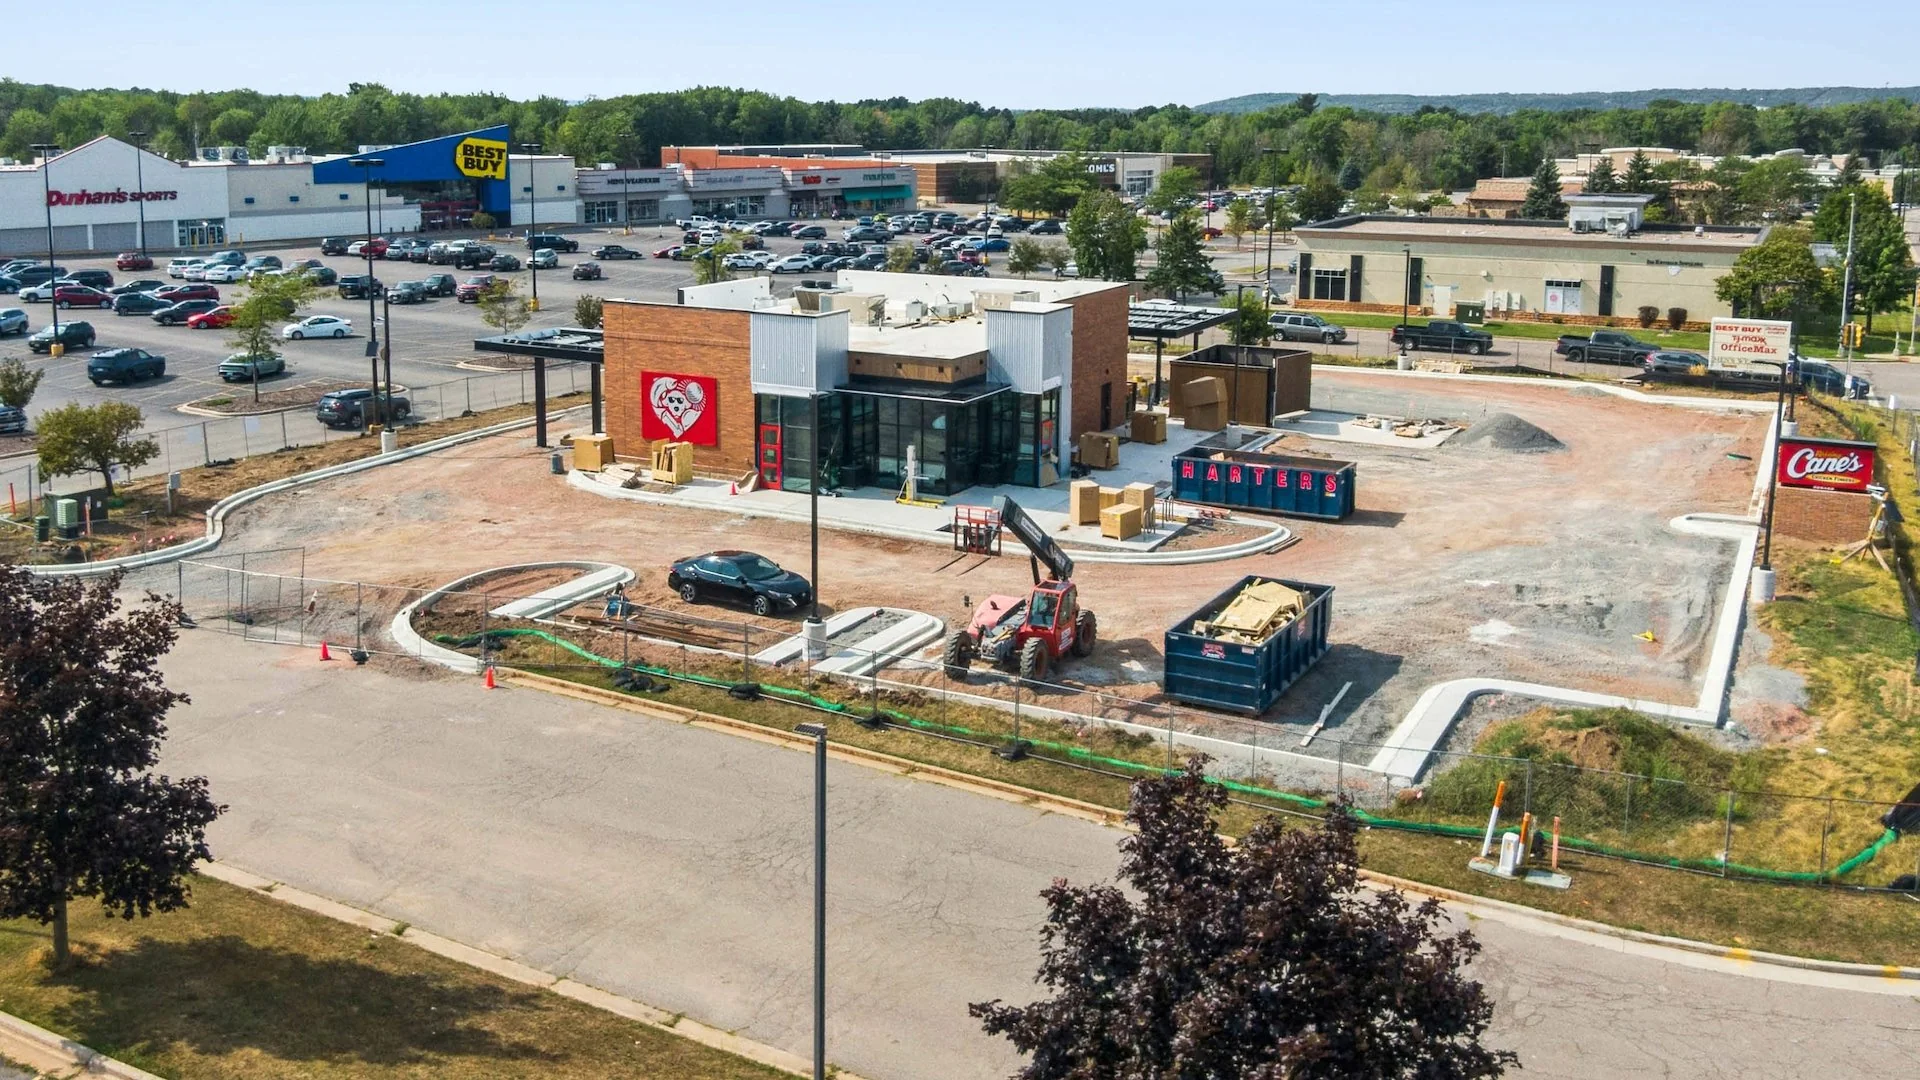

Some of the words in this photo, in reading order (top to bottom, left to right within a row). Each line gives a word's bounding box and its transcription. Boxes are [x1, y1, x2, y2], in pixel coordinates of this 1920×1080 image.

[463, 144, 505, 160] BEST
[464, 157, 502, 172] BUY
[1085, 163, 1115, 173] OHL'S
[47, 187, 128, 206] Dunham's
[129, 190, 178, 202] SPORTS
[1721, 343, 1777, 354] OfficeMax
[1787, 448, 1864, 478] Cane's
[1182, 461, 1336, 492] HARTERS
